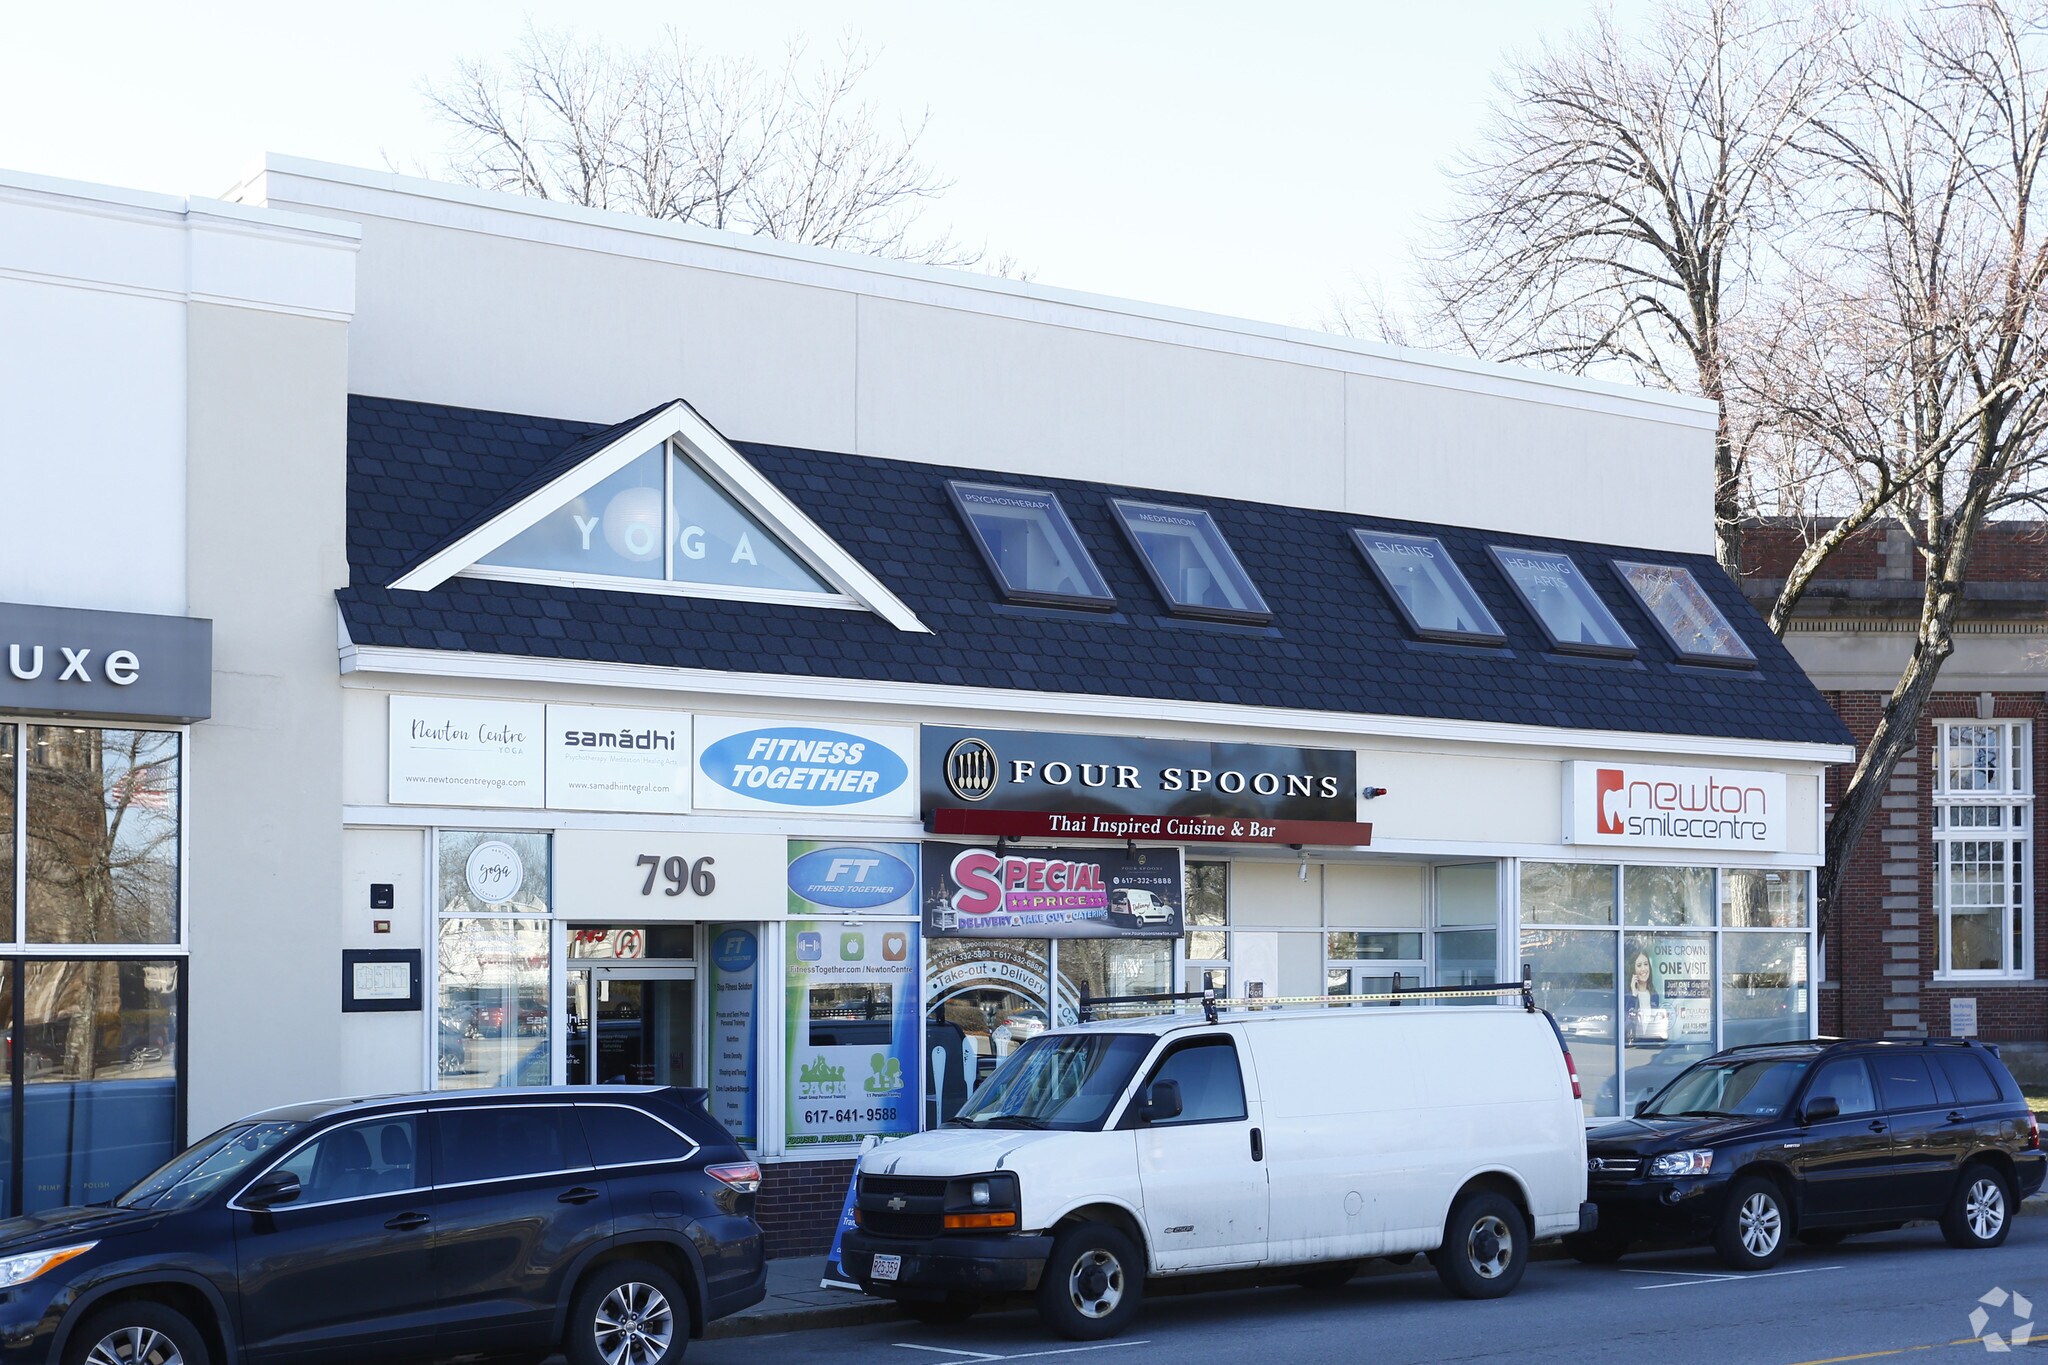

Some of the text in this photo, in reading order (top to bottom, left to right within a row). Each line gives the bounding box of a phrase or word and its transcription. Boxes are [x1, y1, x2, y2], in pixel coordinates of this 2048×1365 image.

[964, 493, 1051, 511] PSYCHOTHERAPY
[1138, 513, 1197, 528] MEDITATION
[573, 515, 758, 566] YOGA
[1374, 541, 1435, 560] EVENTS
[1505, 556, 1571, 576] HEALING
[1533, 574, 1570, 590] ARTS
[411, 718, 528, 744] Newton Centre
[498, 746, 525, 755] YOGA
[746, 737, 866, 765] FITNESS
[405, 774, 527, 790] www.newtoncentreyoga.com
[568, 780, 670, 794] www.samadhiintegral.com
[731, 764, 880, 794] TOGETHER
[1010, 759, 1340, 799] FOUR SPOONS
[1628, 776, 1767, 815] newton
[1049, 814, 1276, 838] Thai Inspired Cuisine & Bar
[1628, 811, 1767, 842] smilecentre
[478, 863, 512, 885] yoga
[636, 854, 717, 897] 796
[825, 858, 881, 883] FT
[807, 884, 895, 895] FITNESS TOGETHER
[953, 851, 1107, 913] SPECIAL
[1121, 877, 1172, 885] 617-332-5888
[1033, 894, 1088, 907] PRICE
[958, 908, 1109, 930] DELIVERY TAKE OUT CATERING
[725, 936, 747, 955] FT
[1654, 945, 1709, 956] ONE CROWN.
[790, 965, 862, 976] FitnessTogether.com
[865, 965, 913, 974] NewtonCentre
[1658, 961, 1709, 975] ONE VISIT.
[937, 962, 1047, 995] Take-out Delivery
